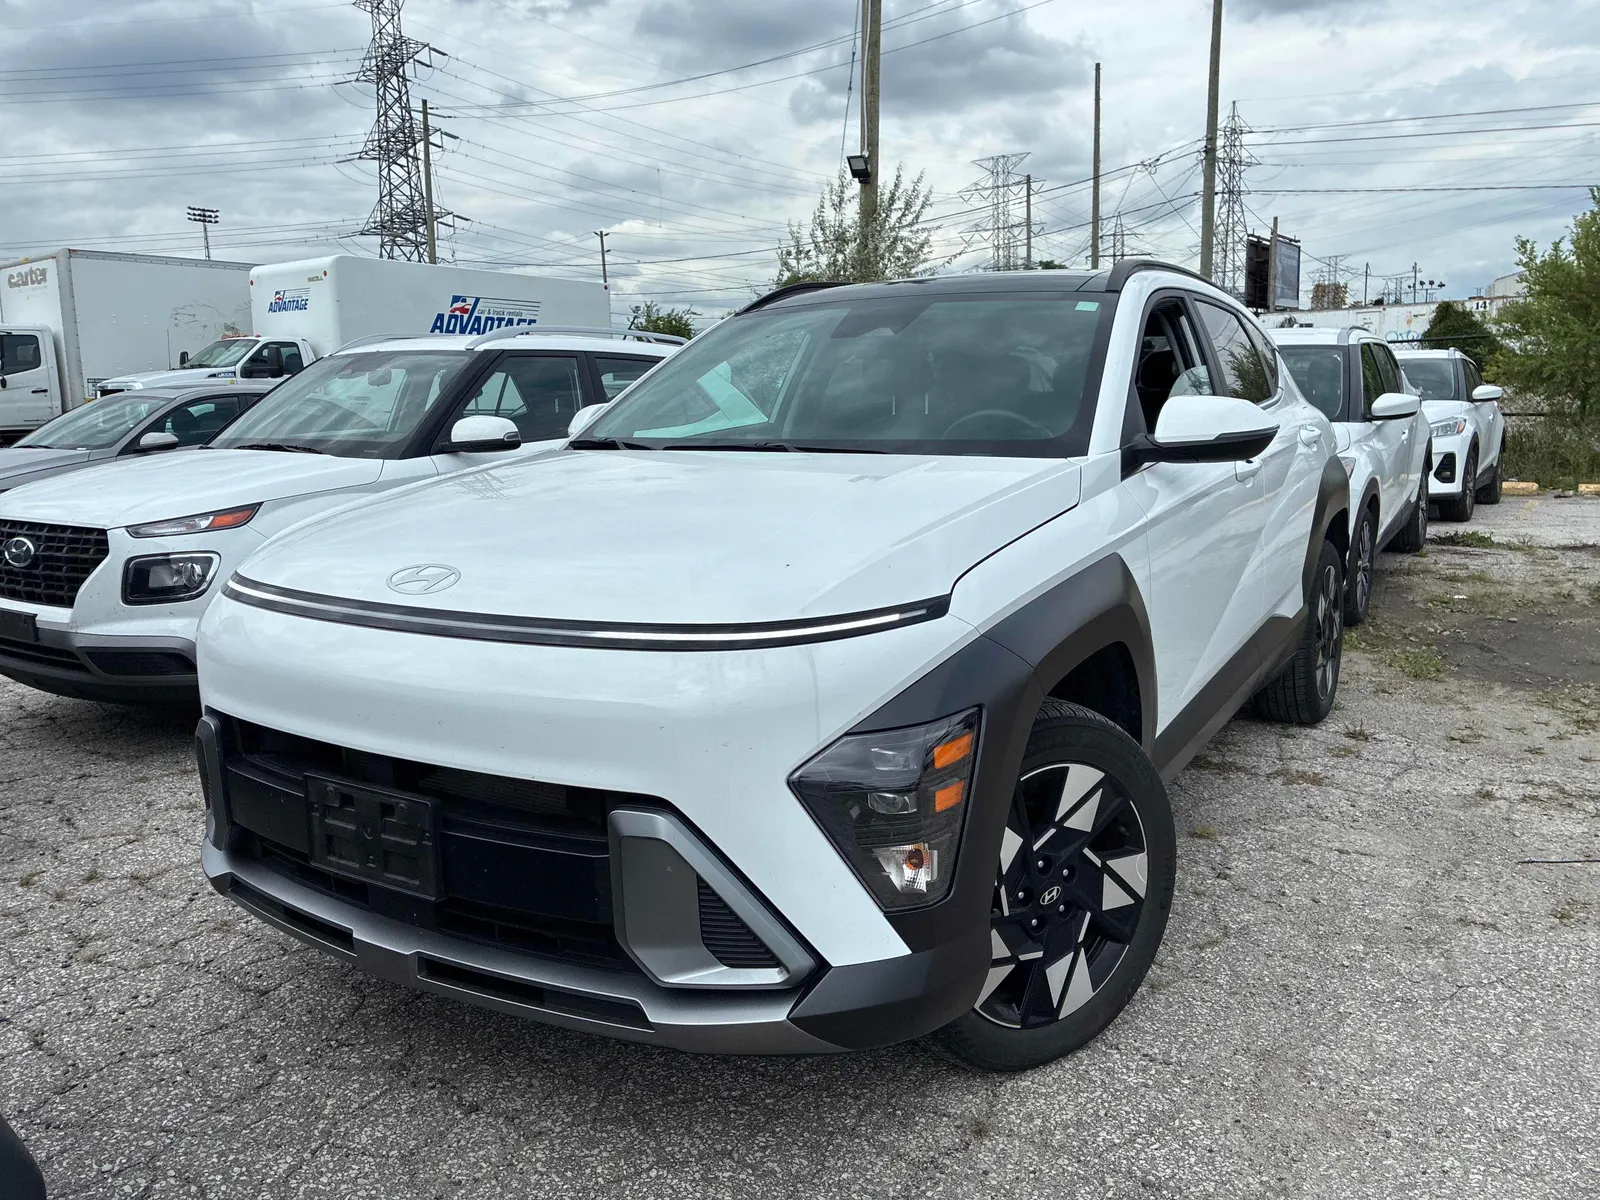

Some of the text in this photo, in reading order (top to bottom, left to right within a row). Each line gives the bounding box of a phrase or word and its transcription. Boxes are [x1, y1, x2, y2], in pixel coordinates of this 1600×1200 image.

[268, 298, 309, 313] ADVANTAGE
[1475, 301, 1488, 310] 14
[492, 309, 505, 317] truck
[505, 310, 523, 318] rentals
